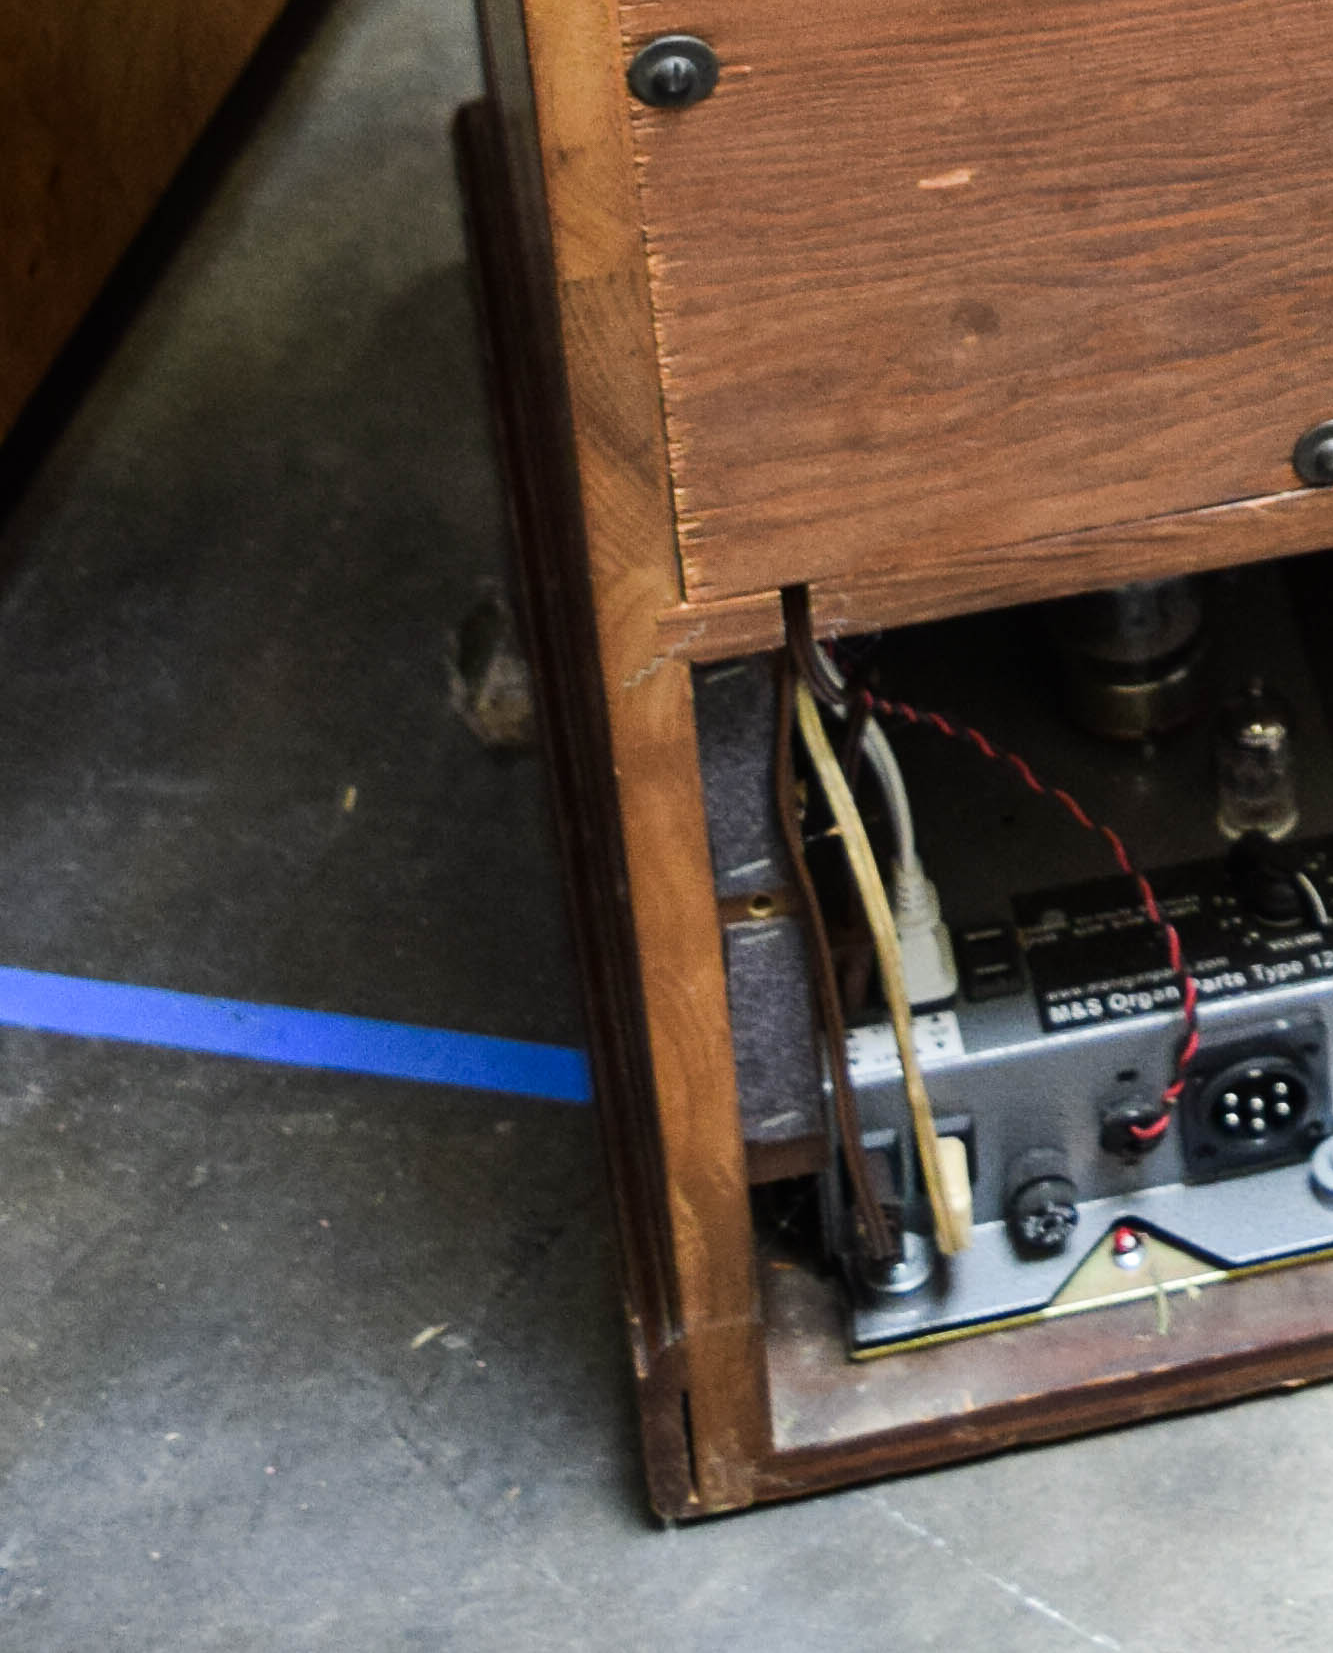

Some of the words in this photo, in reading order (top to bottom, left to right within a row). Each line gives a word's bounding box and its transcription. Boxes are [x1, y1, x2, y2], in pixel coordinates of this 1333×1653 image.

[1048, 1000, 1103, 1025] M&S
[1108, 986, 1181, 1011] Organ
[1250, 960, 1305, 983] Type
